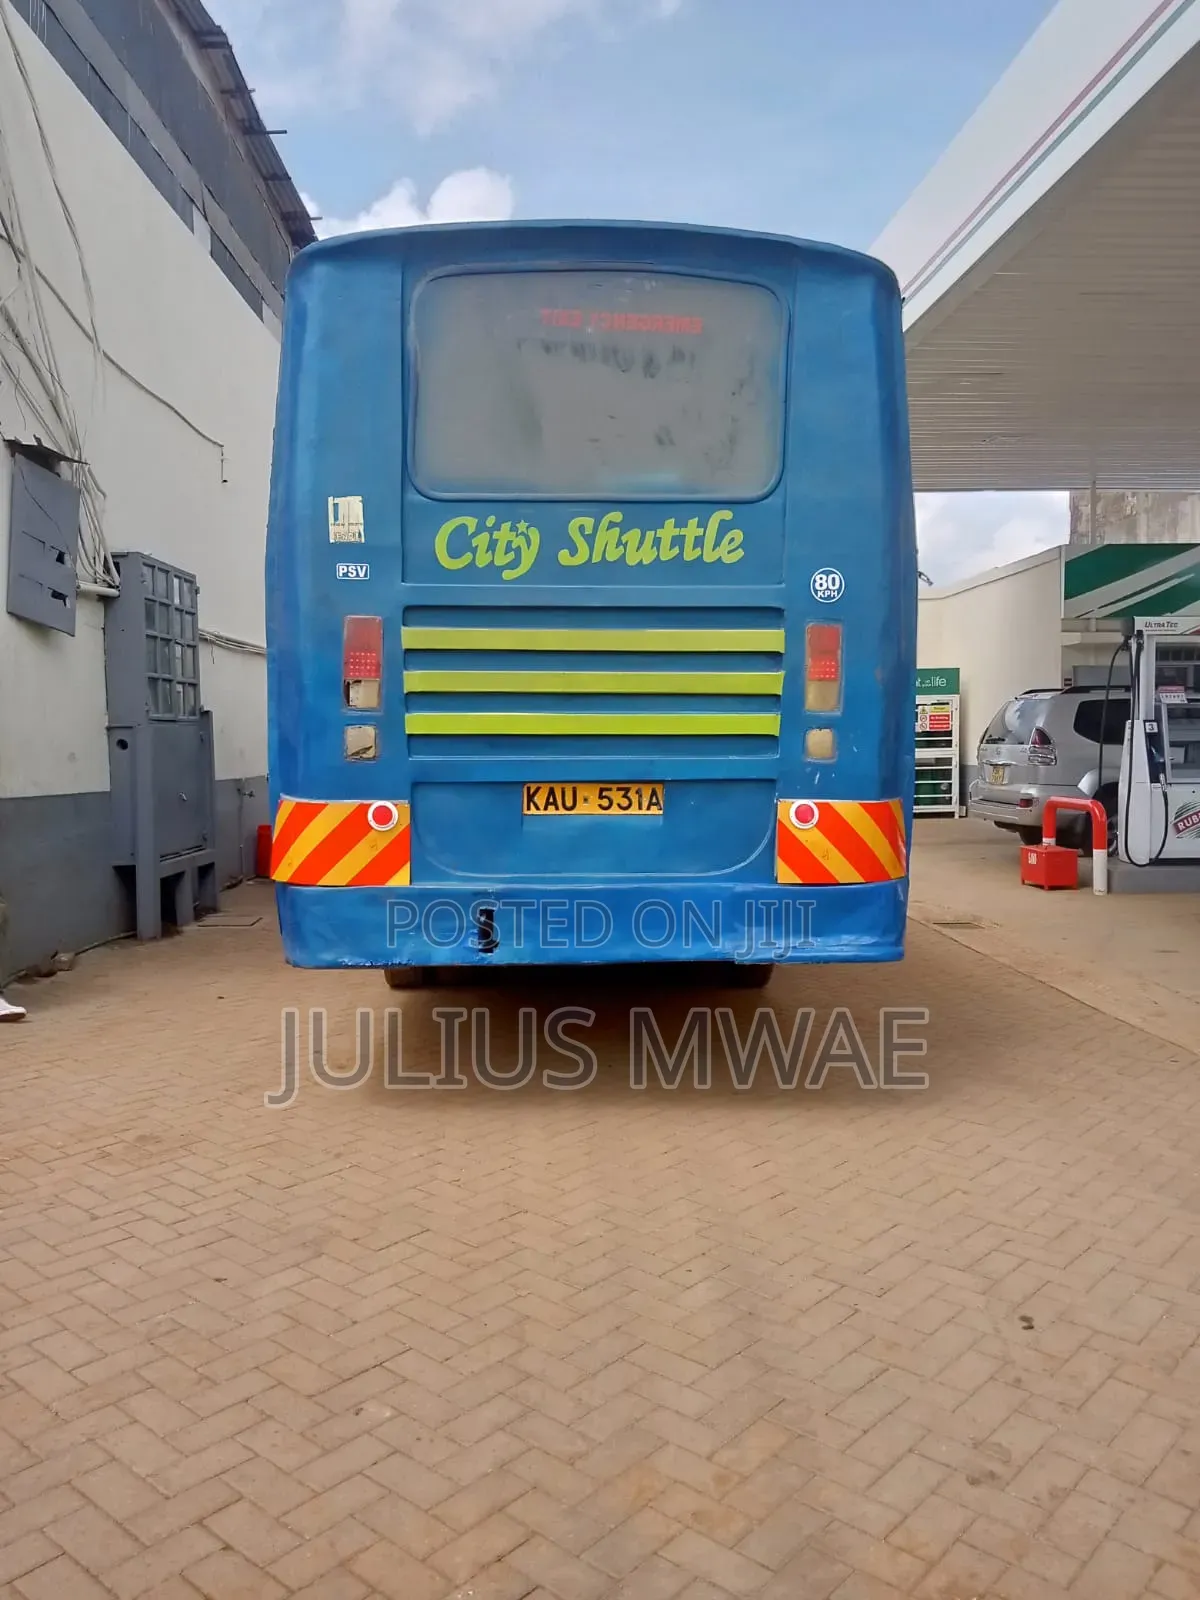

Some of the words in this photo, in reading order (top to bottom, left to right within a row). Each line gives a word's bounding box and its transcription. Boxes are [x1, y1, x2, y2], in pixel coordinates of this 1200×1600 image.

[434, 515, 540, 581] City
[558, 509, 745, 567] Shuttle
[338, 565, 367, 578] PSV
[815, 574, 840, 590] 80
[817, 590, 838, 598] KPH
[931, 676, 947, 687] life
[526, 786, 578, 811] KAU
[597, 786, 663, 811] 531A
[1177, 813, 1200, 831] RUB
